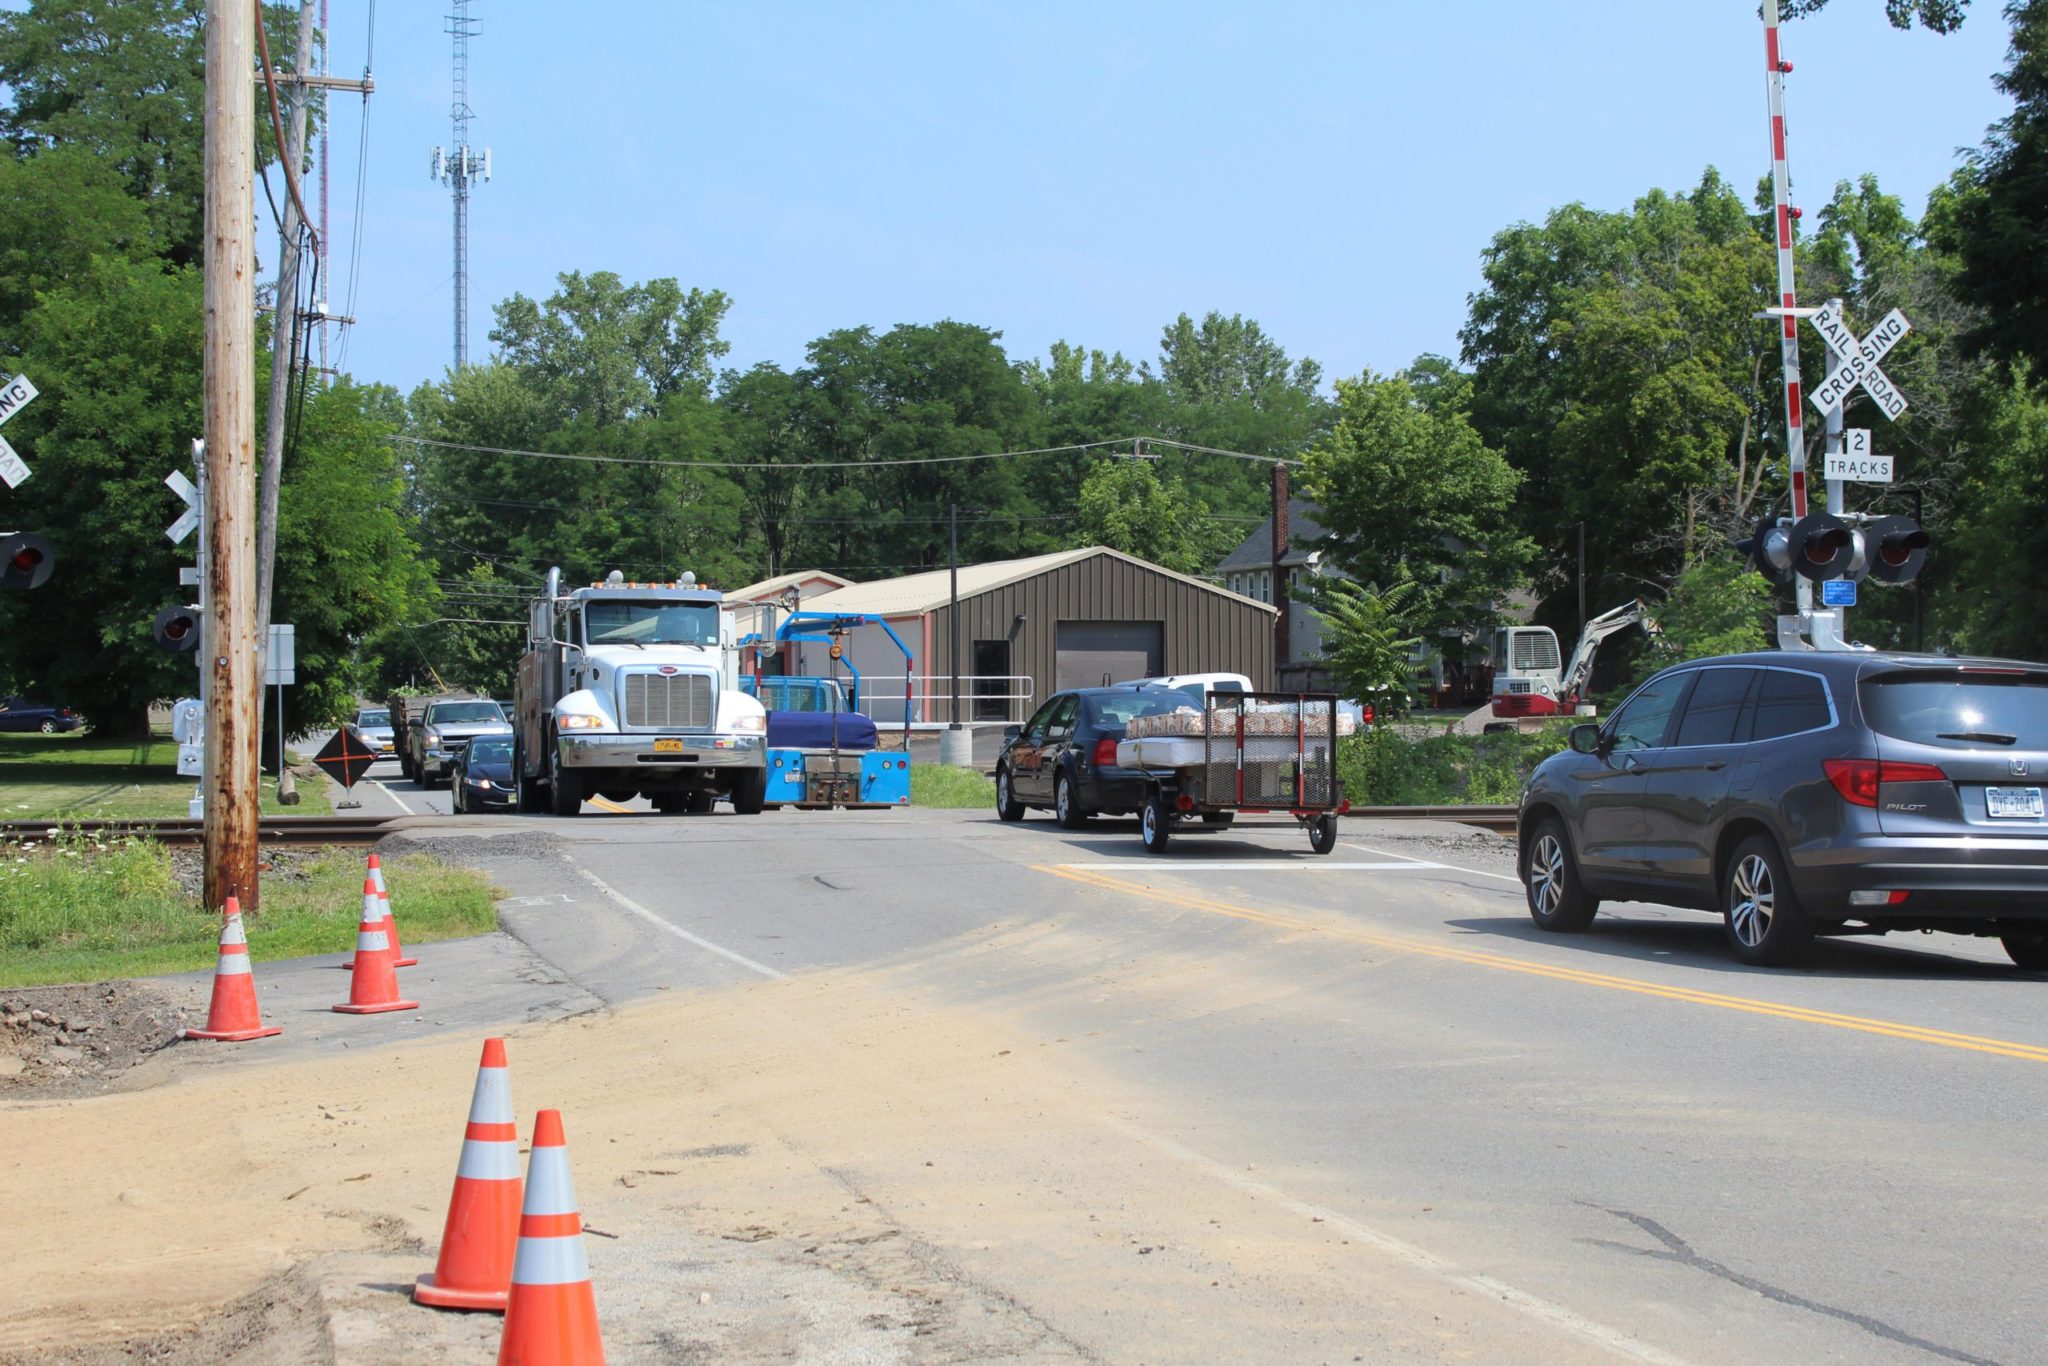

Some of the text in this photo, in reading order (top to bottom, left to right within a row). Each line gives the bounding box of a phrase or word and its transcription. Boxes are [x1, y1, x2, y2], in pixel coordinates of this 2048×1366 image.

[1815, 310, 1903, 416] RAIL ROAD
[1820, 318, 1901, 405] CROSSING
[1854, 432, 1864, 450] 2
[1829, 460, 1889, 475] TRACKS
[1886, 803, 1927, 811] PILOT
